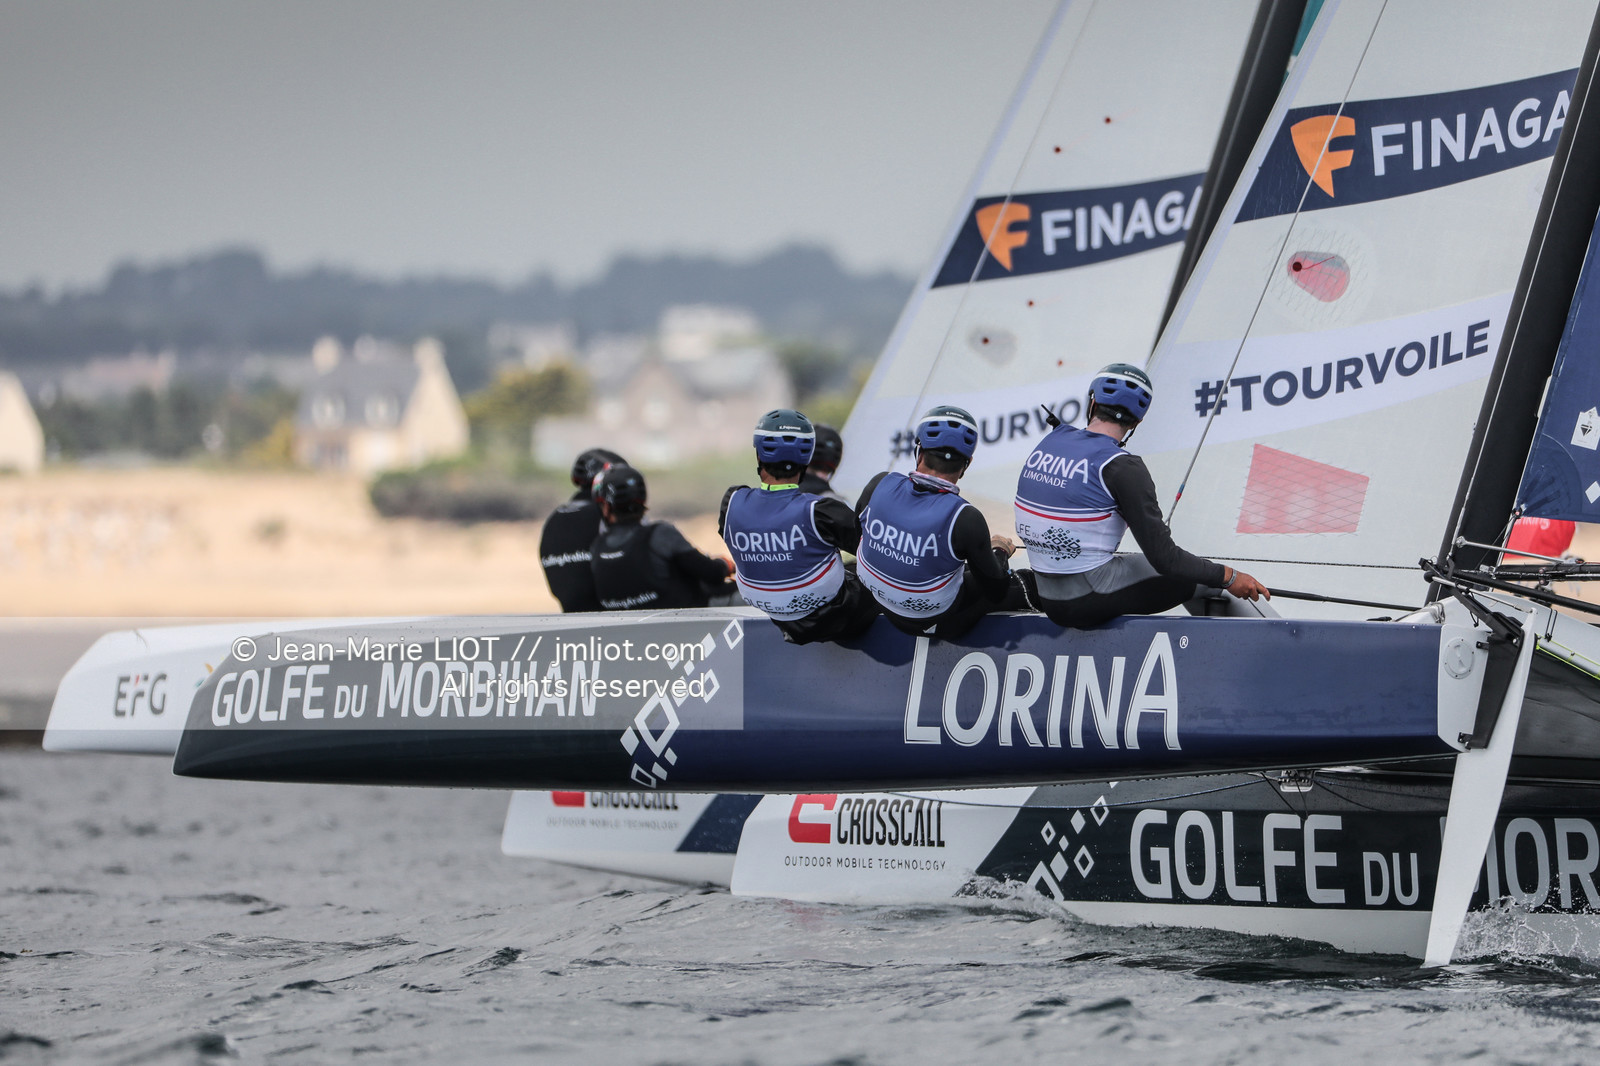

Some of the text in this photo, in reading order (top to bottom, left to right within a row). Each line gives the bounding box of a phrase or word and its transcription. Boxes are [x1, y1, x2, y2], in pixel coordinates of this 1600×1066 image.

[1195, 319, 1491, 418] #TOURVOILE
[1023, 469, 1068, 489] LIMONADE
[1026, 450, 1088, 484] ORINA
[740, 551, 793, 562] LIMONADE
[868, 539, 920, 567] LIMONADE
[212, 660, 601, 727] GOLFE DU MORBIHAN
[837, 798, 946, 848] CROSSCALL
[784, 855, 946, 871] OUTDOOR MOBILE TECHNOLOGY
[1130, 809, 1346, 904] GOLFE
[1363, 850, 1419, 905] DU
